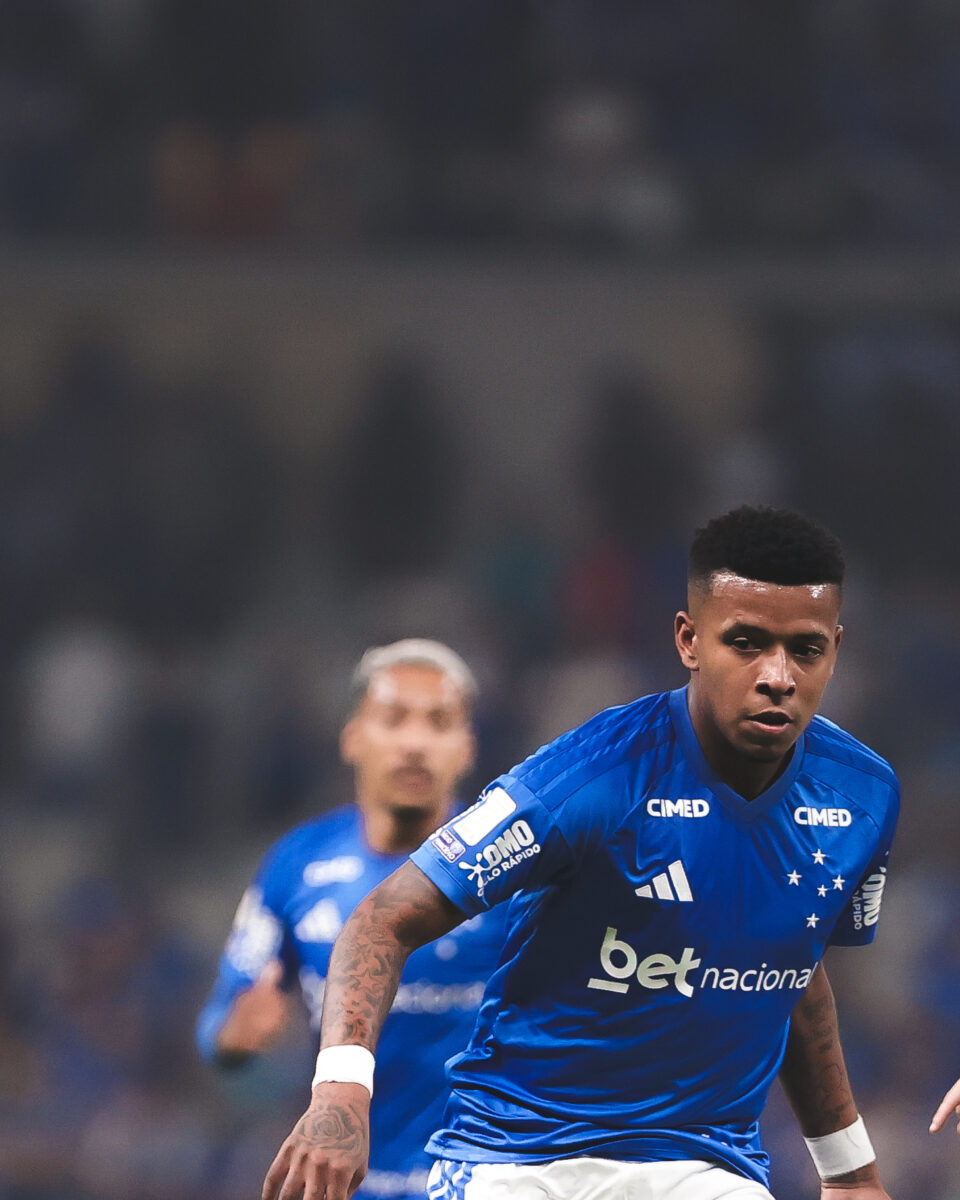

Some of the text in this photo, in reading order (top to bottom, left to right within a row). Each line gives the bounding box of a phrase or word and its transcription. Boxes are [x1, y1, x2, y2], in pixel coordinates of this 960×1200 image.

[646, 799, 710, 818] CIMED
[794, 806, 852, 827] CIMED
[482, 819, 535, 868] OMO
[501, 843, 541, 872] RÁPIDO
